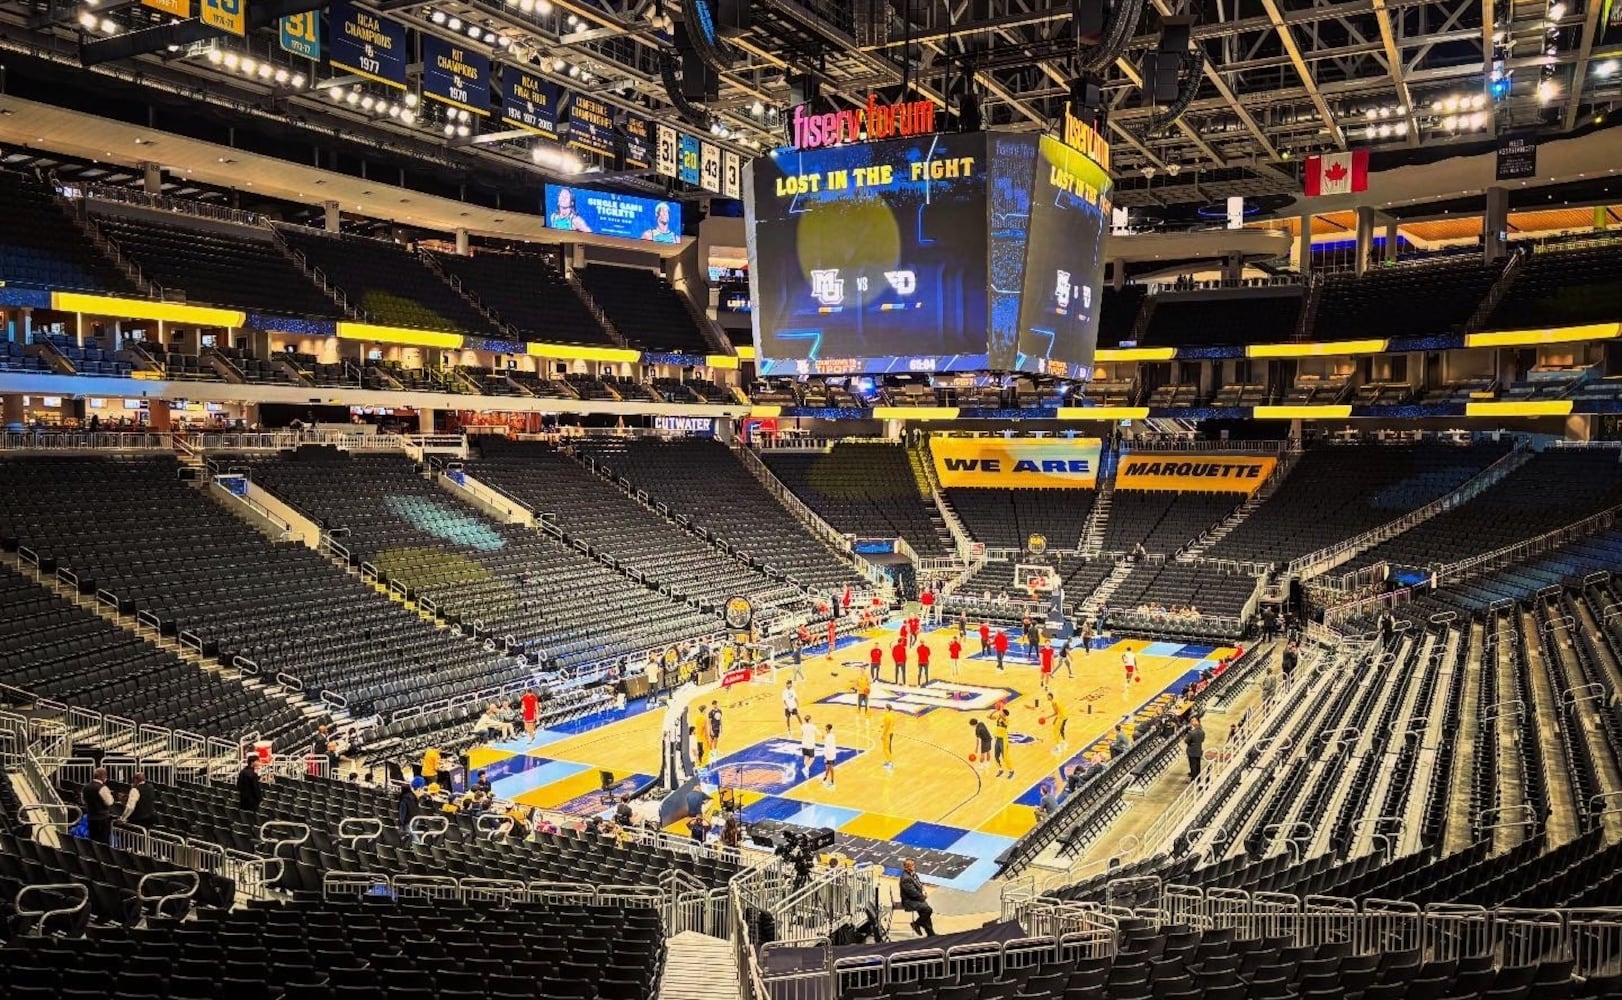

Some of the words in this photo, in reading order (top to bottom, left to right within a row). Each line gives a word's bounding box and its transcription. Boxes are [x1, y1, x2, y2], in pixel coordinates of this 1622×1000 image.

[357, 12, 380, 33] NCAA
[344, 20, 392, 50] CHAMPIONS
[359, 56, 380, 74] 1977
[437, 55, 478, 80] CHAMPIONS
[449, 86, 468, 103] 1970
[538, 118, 553, 132] 2003
[793, 105, 860, 151] fiserv
[867, 93, 935, 140] forum
[662, 140, 674, 164] 31
[705, 159, 718, 179] 43
[729, 165, 736, 186] 3
[776, 173, 821, 197] LOST
[827, 169, 848, 190] IN
[852, 165, 894, 188] THE
[910, 157, 975, 181] FIGHT
[1050, 165, 1074, 194] LOST
[810, 269, 845, 304] MU
[856, 277, 868, 292] VS
[655, 417, 711, 432] CUTWATER
[944, 457, 1001, 472] WE
[1012, 459, 1090, 473] ARE
[1124, 462, 1262, 478] MARQUETTE
